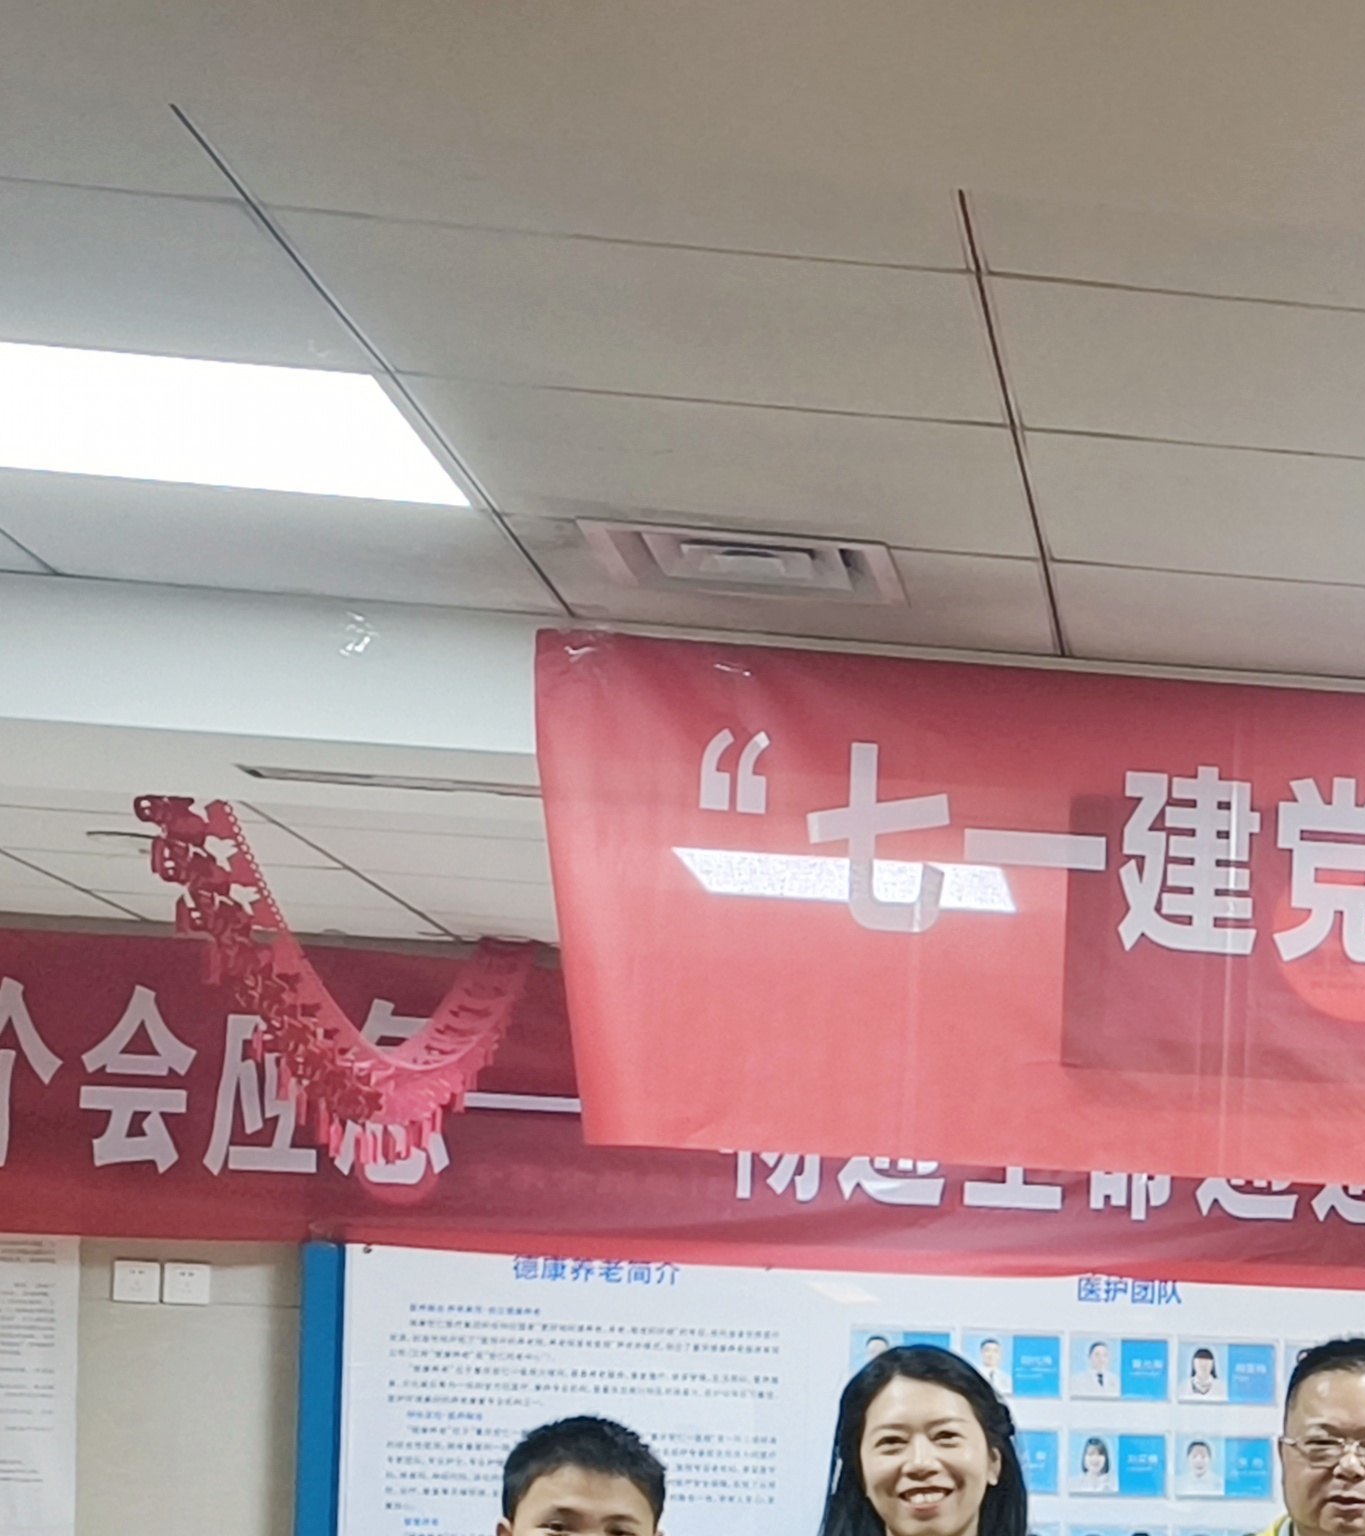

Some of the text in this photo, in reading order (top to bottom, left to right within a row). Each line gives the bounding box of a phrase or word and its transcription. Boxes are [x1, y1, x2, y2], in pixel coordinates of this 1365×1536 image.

[513, 1255, 680, 1286] 德康养老简介
[1078, 1277, 1182, 1305] 医护团队
